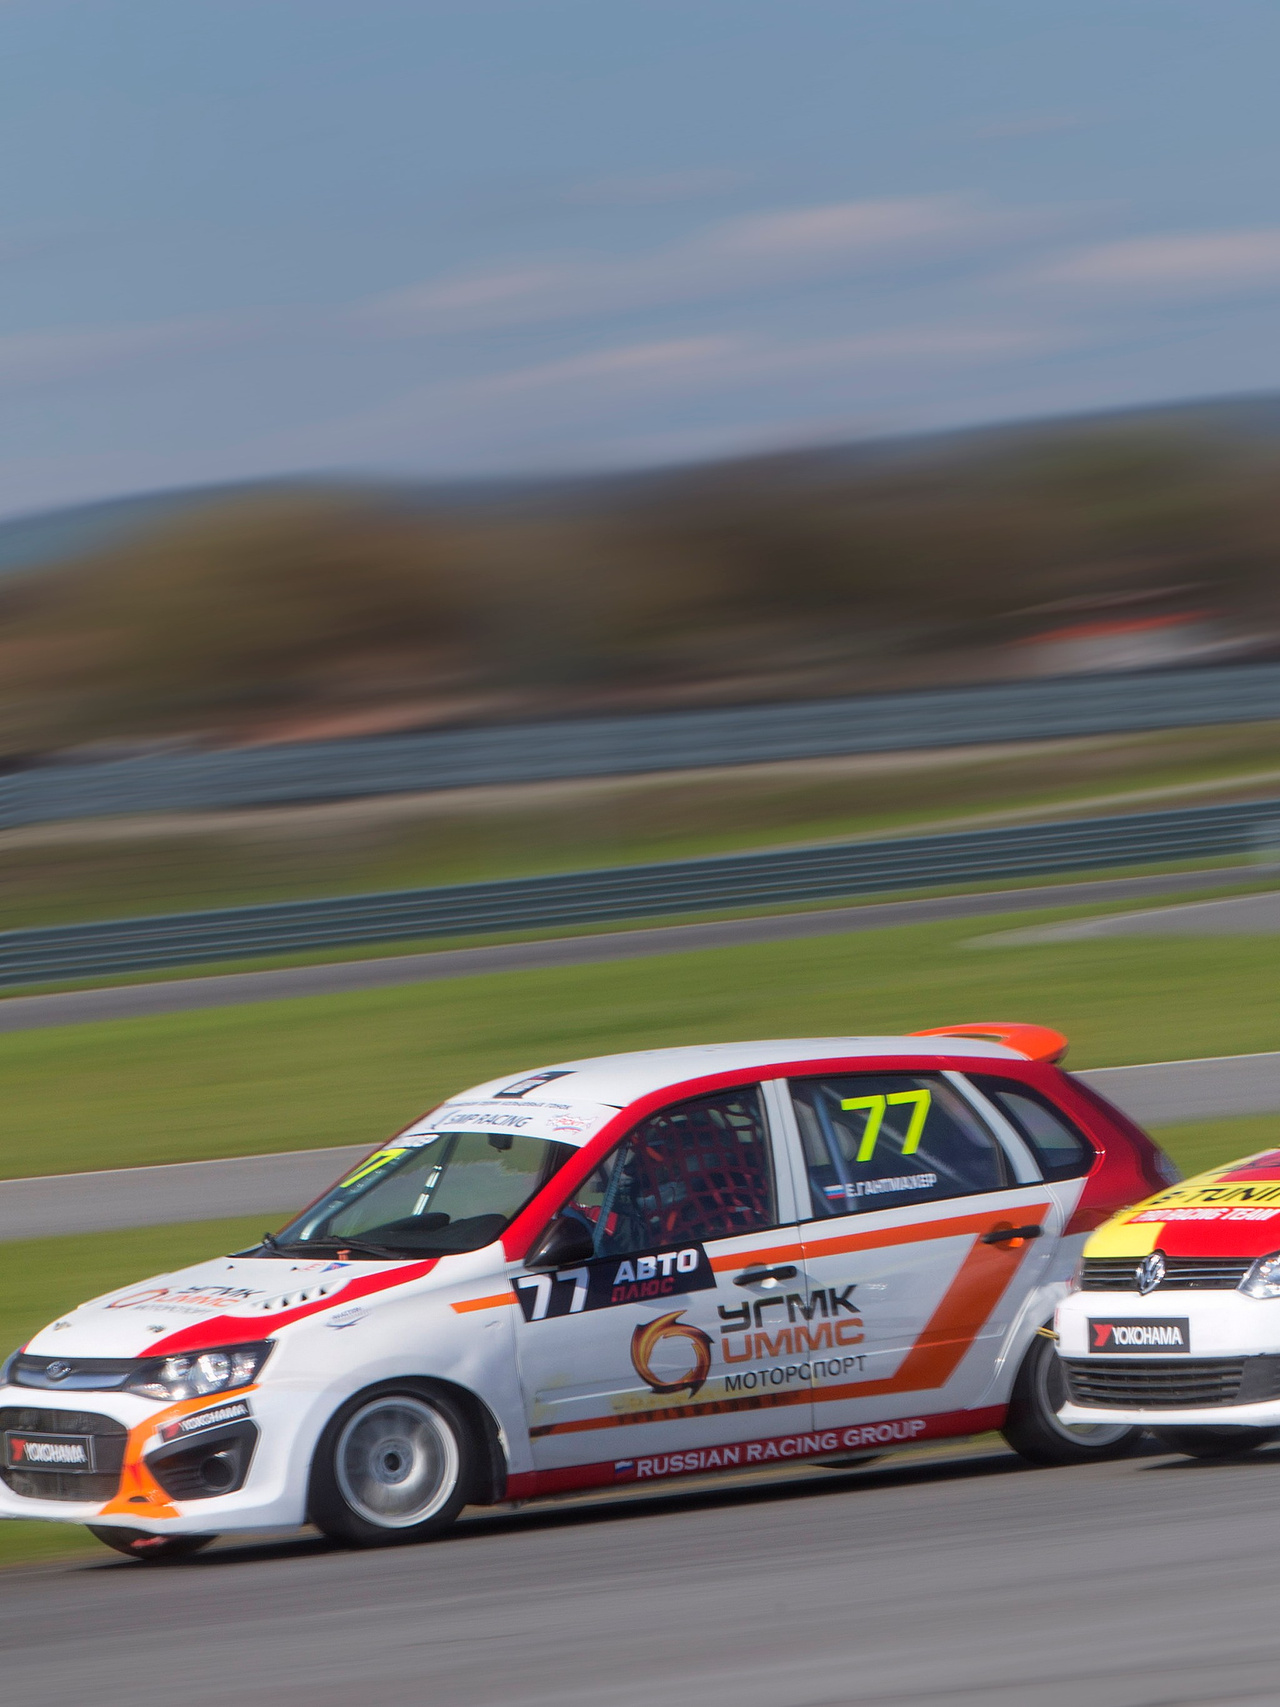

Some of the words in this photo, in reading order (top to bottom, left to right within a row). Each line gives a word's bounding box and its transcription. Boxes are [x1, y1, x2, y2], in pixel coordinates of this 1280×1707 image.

[475, 1113, 534, 1128] RACING
[841, 1089, 931, 1162] 77
[1169, 1207, 1229, 1221] RACING
[612, 1248, 700, 1285] АВТО
[518, 1266, 590, 1321] 77
[611, 1277, 675, 1303] ПЛЮС
[717, 1284, 862, 1334] УГМК
[721, 1317, 866, 1364] UMMC
[1111, 1325, 1184, 1346] YOKOHAMA
[724, 1355, 868, 1392] МОТОРСПОРТ
[178, 1403, 250, 1432] YOKOHAMA
[23, 1442, 88, 1463] YOKOHAMA
[636, 1447, 740, 1478] RUSSIAN
[746, 1432, 839, 1462] RACING
[843, 1419, 926, 1447] GROUP
